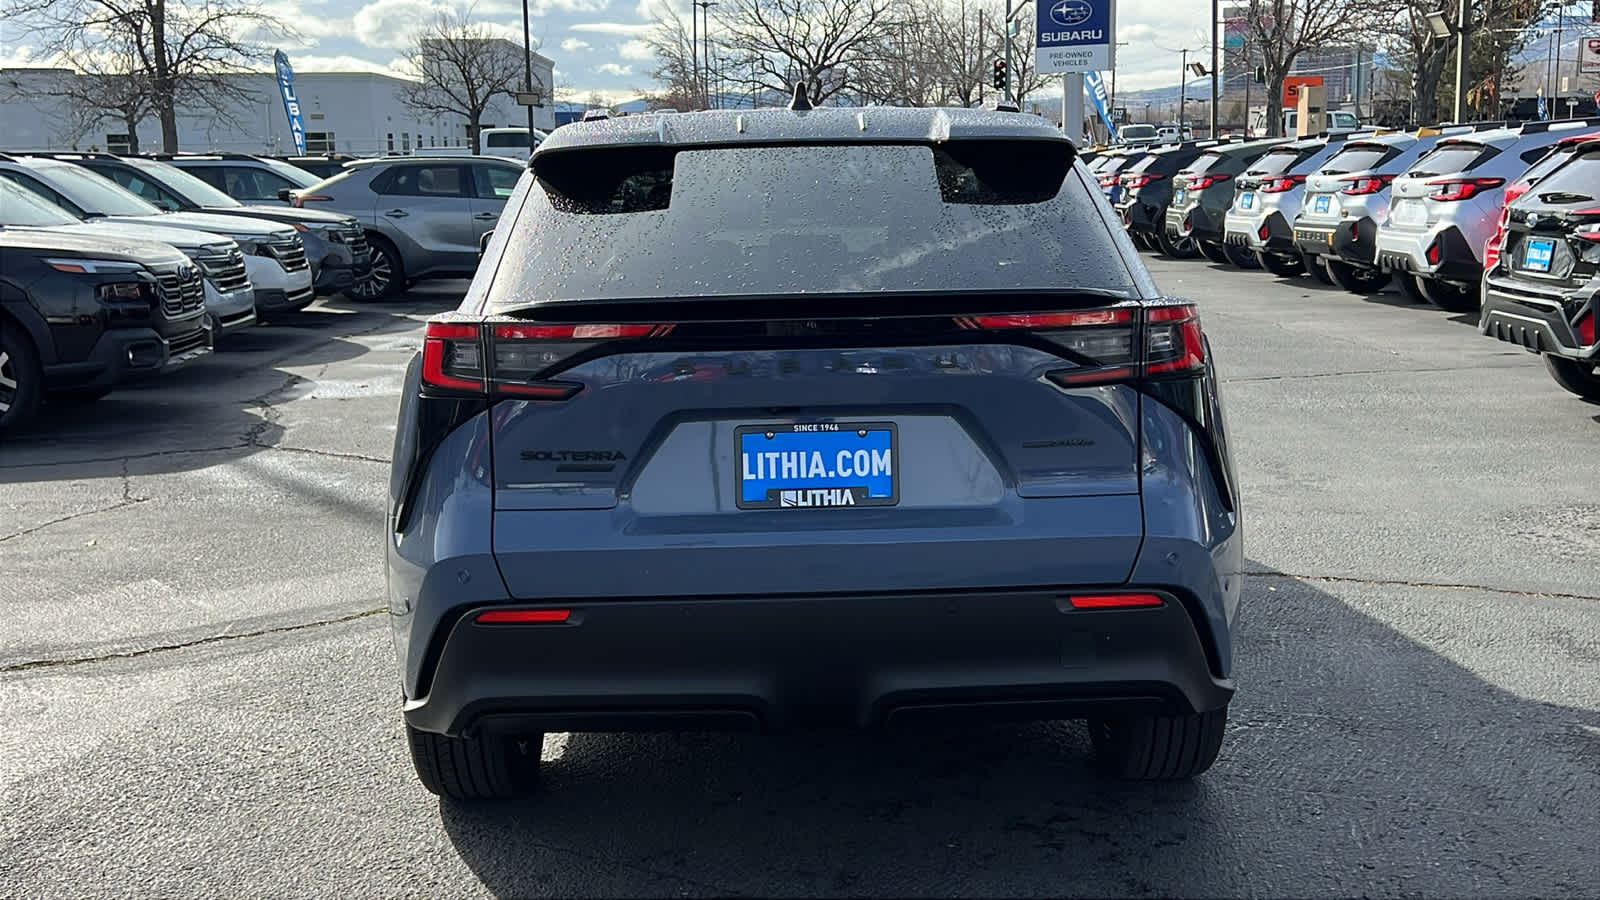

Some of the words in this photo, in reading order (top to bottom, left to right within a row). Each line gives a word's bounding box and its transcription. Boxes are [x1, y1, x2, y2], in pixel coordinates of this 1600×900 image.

[1041, 29, 1103, 42] SUBARU
[1050, 51, 1093, 60] PRE-OWNED
[793, 424, 818, 432] SINCE
[820, 423, 839, 431] 1946
[519, 450, 627, 461] SOLTERRA
[742, 449, 892, 480] LITHIA.COM
[797, 488, 855, 507] LITHIA
